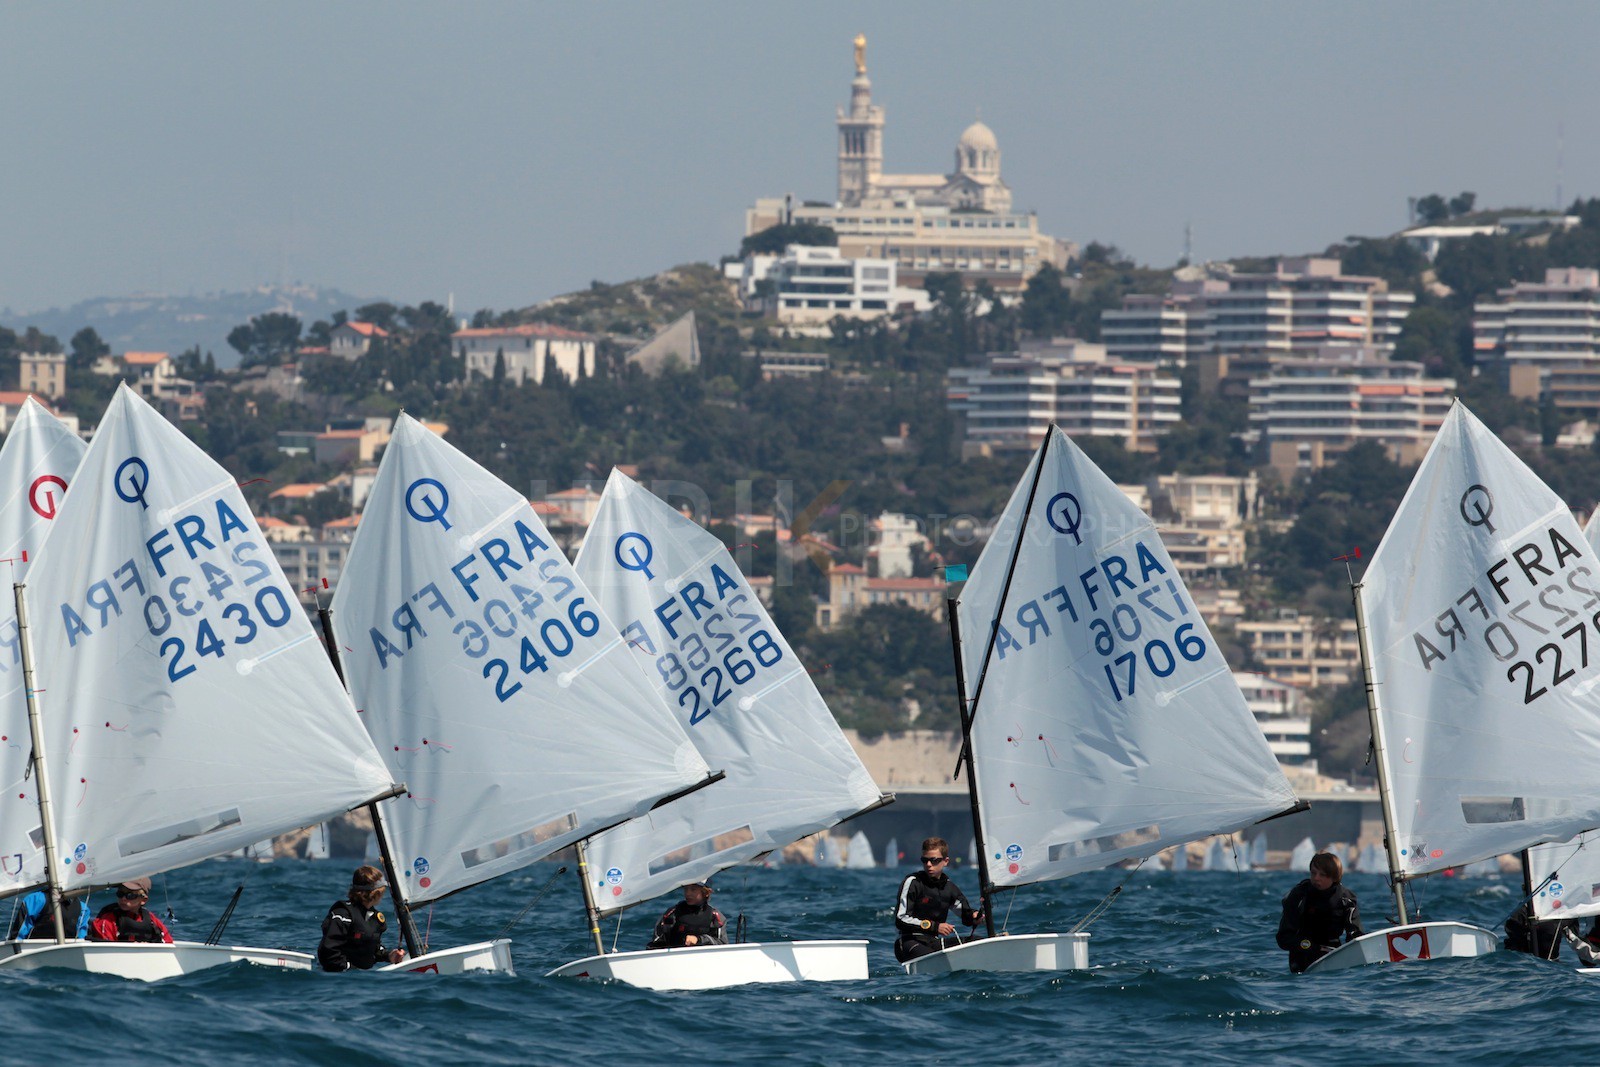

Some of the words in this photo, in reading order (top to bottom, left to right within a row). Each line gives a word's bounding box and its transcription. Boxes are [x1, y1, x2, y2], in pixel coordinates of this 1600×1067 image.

[145, 498, 249, 578] FRA
[452, 520, 549, 602] FRA
[1079, 541, 1166, 611] FRA
[1486, 527, 1582, 605] FRA
[159, 585, 292, 683] 2430
[654, 564, 739, 640] FRA
[482, 597, 600, 703] 2406
[678, 630, 783, 726] 2268
[1103, 623, 1206, 702] 1706
